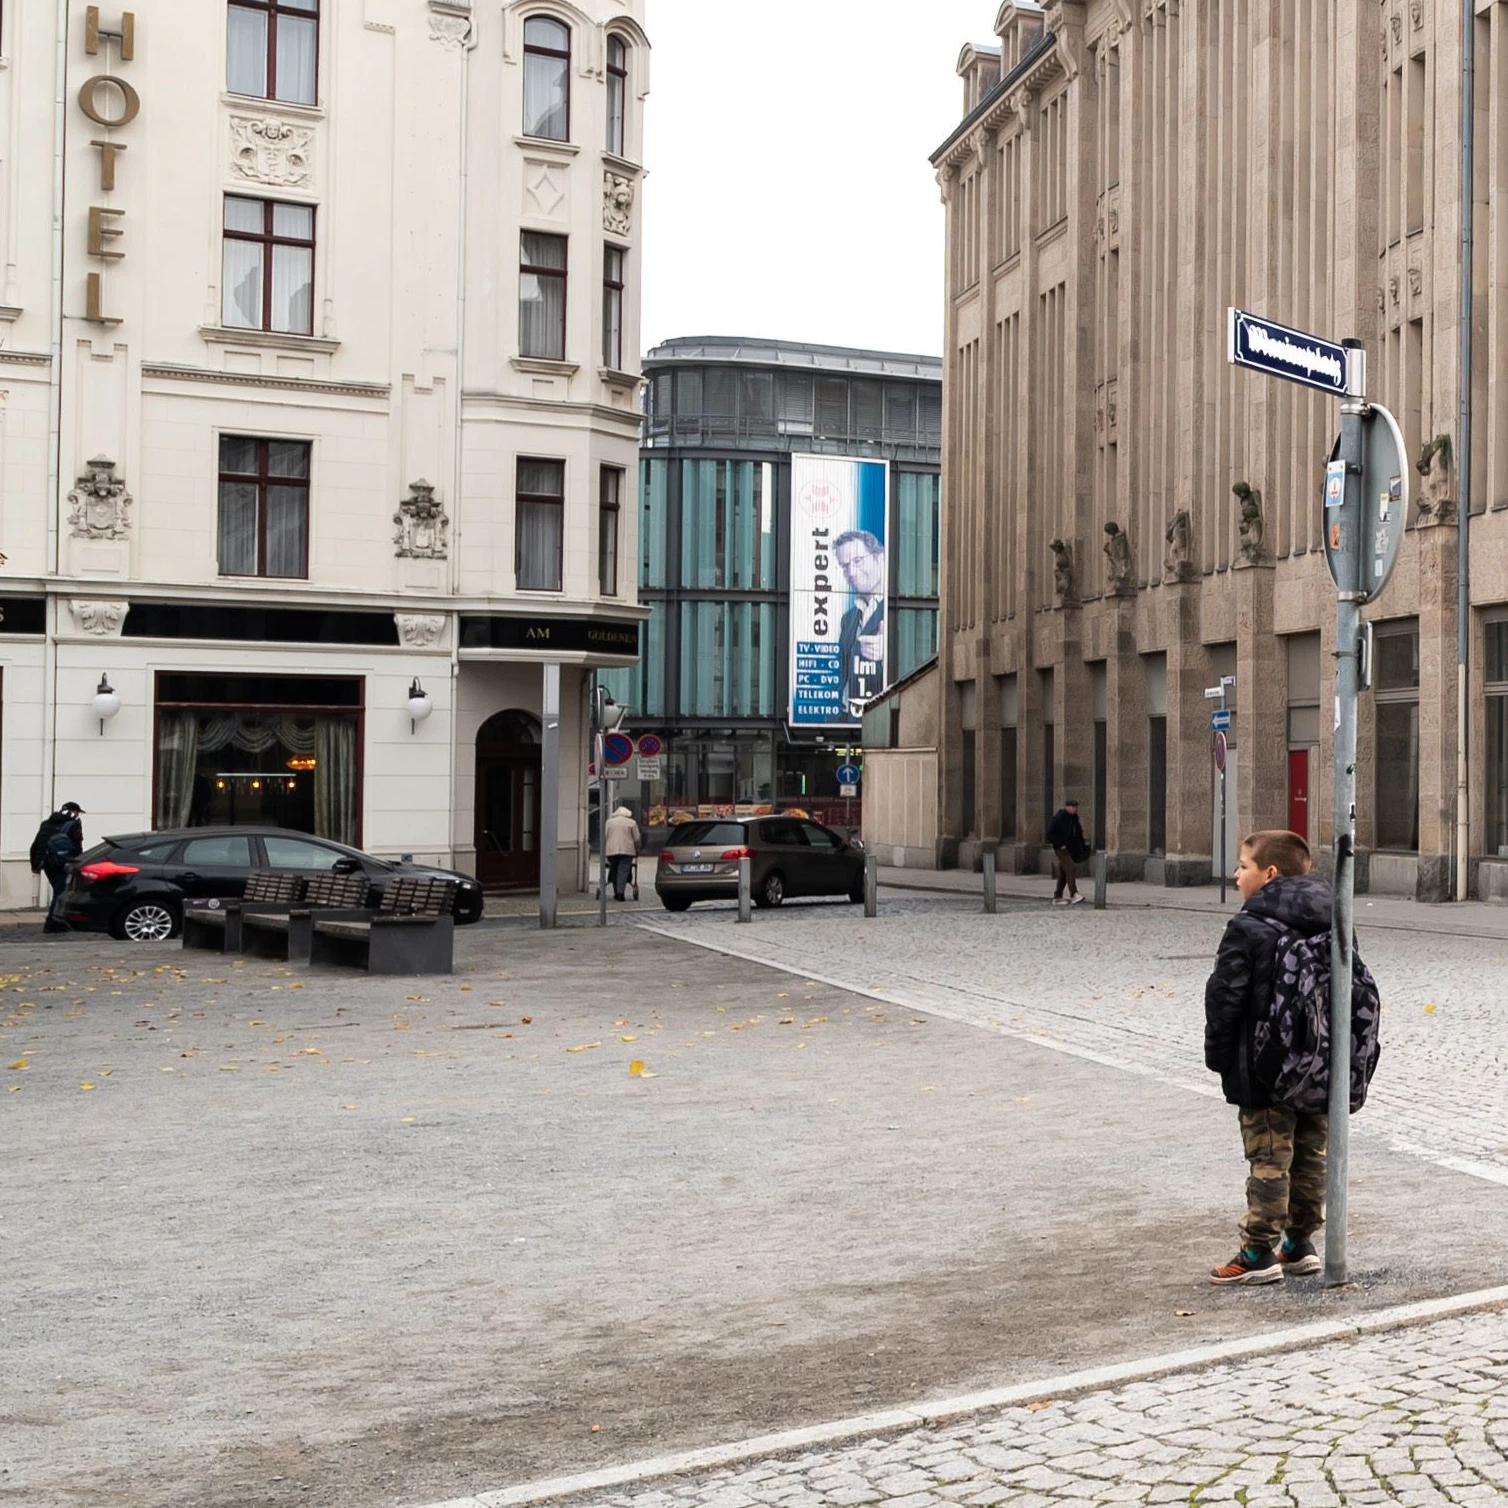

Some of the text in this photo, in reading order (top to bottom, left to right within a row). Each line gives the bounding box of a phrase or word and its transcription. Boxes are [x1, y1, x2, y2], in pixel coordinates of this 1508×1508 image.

[77, 5, 141, 325] HOTEL
[812, 527, 832, 636] expert
[525, 627, 550, 640] AM
[854, 655, 877, 675] Im
[798, 674, 810, 683] PC
[798, 690, 840, 699] TELEKOM
[797, 705, 840, 714] ELEKTRO
